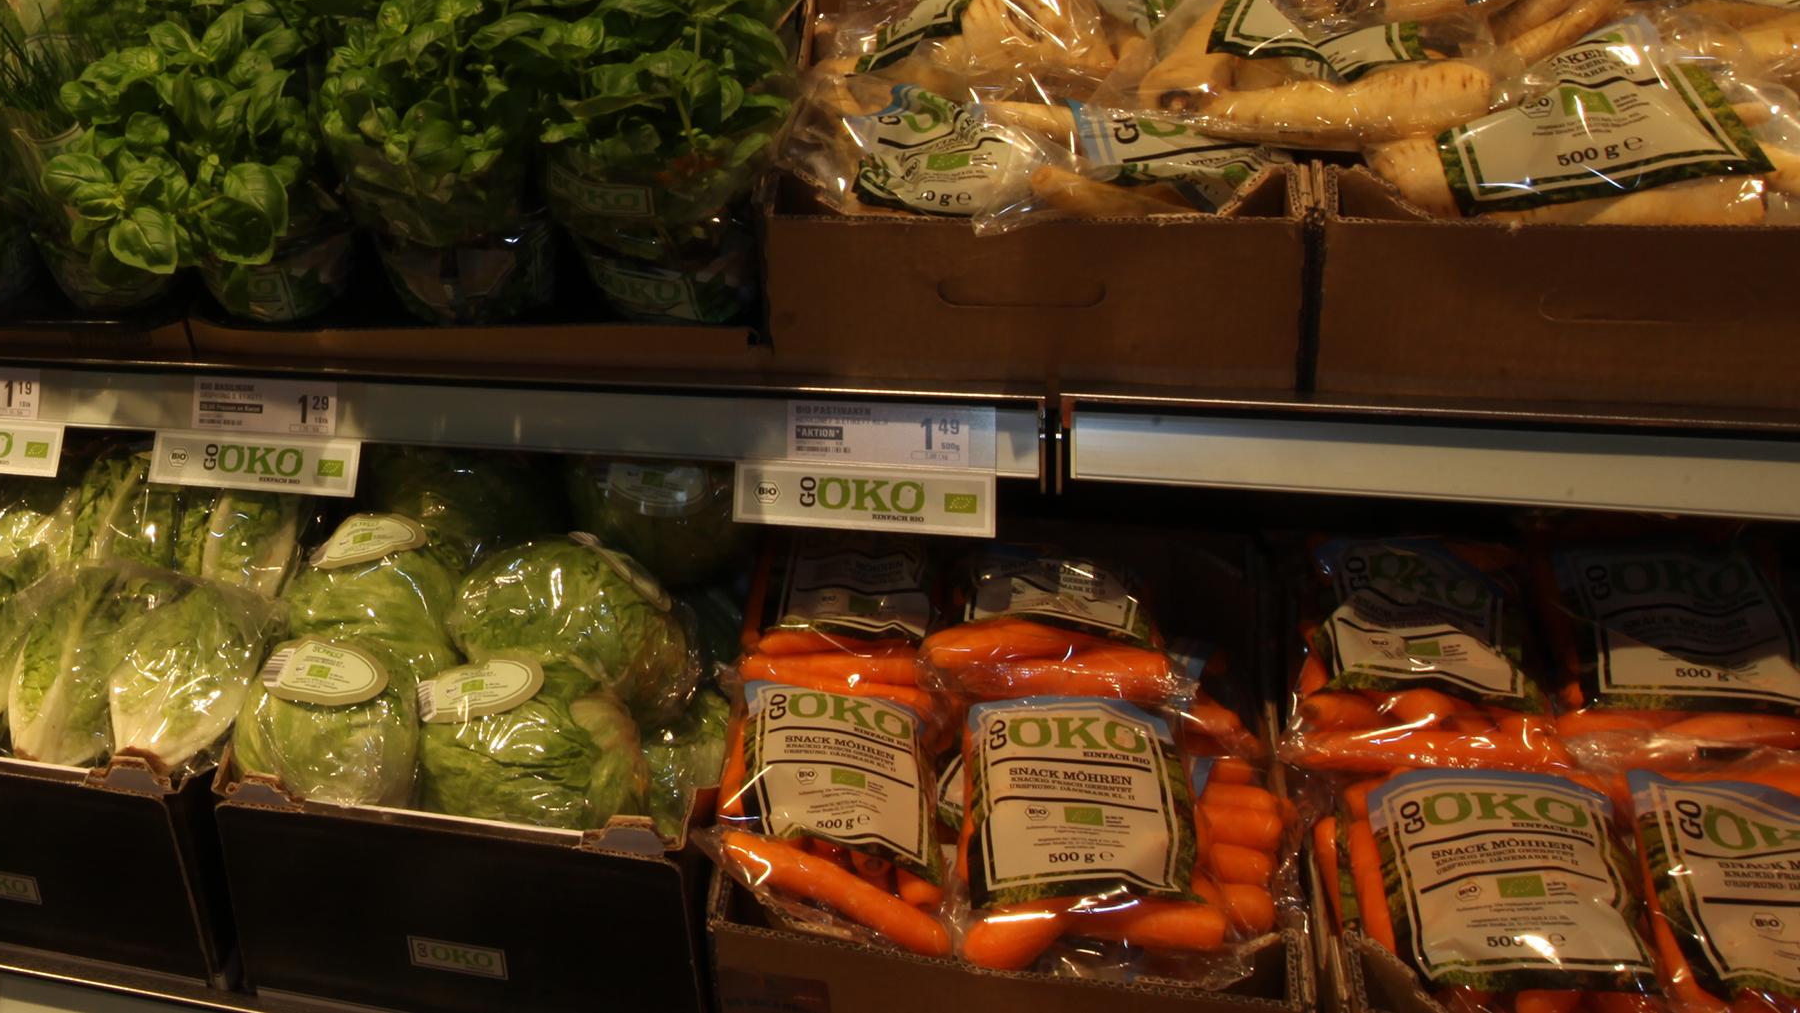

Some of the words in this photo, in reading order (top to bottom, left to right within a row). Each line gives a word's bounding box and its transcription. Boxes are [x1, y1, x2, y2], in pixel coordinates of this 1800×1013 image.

[1556, 147, 1599, 167] 500
[1604, 142, 1619, 159] g
[18, 380, 32, 395] 19
[311, 395, 329, 411] 29
[938, 418, 961, 436] 49
[203, 443, 219, 471] GO
[800, 476, 817, 508] GO
[817, 477, 926, 514] ÖKO
[909, 515, 925, 523] BIO
[1586, 564, 1611, 600] GO
[1675, 667, 1711, 678] 500
[769, 693, 787, 720] GO
[990, 719, 1007, 750] GO
[784, 735, 830, 745] SNACK
[834, 738, 895, 761] MÖHREN
[1083, 751, 1130, 761] EINFACH
[1131, 757, 1150, 765] BIO
[1009, 767, 1059, 779] SNACK
[1063, 769, 1132, 786] MÖHREN
[816, 818, 843, 829] 500
[845, 818, 855, 829] g
[1401, 800, 1425, 835] GO
[1676, 799, 1703, 840] GO
[1512, 821, 1569, 834] EINFACH
[1571, 829, 1594, 839] BIO
[1049, 852, 1079, 863] 500
[1084, 853, 1095, 863] g
[1431, 844, 1487, 860] SNACK
[1492, 838, 1575, 852] MÖHREN
